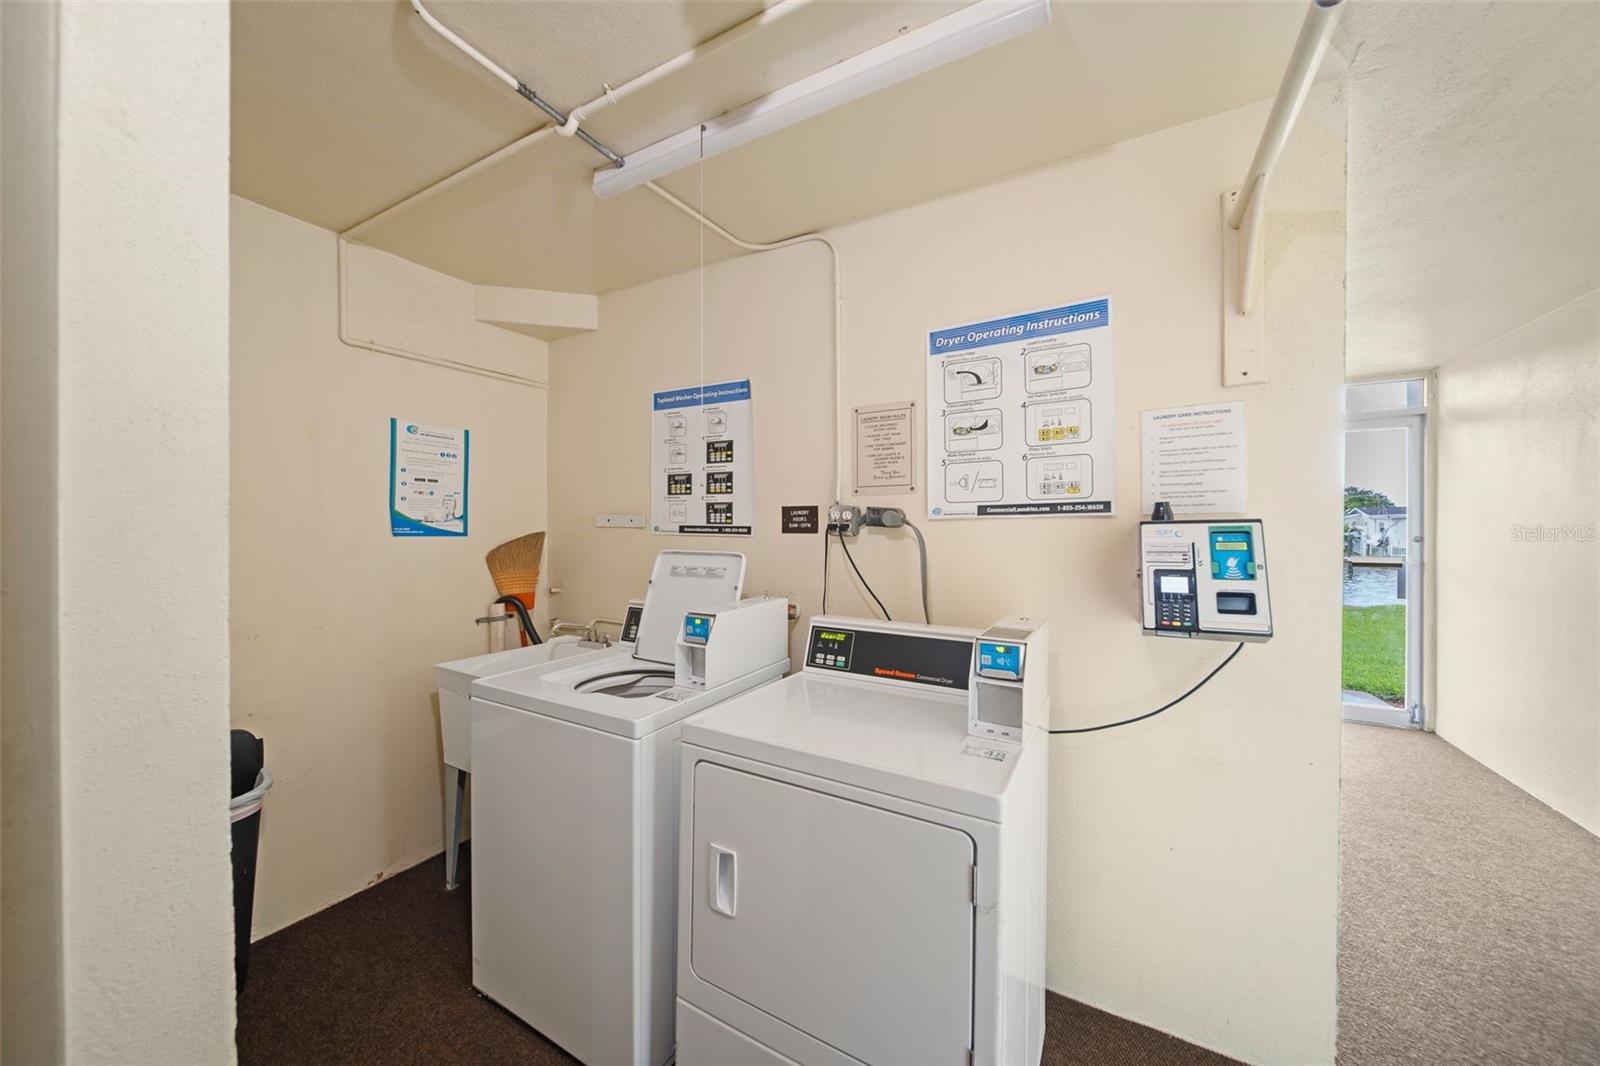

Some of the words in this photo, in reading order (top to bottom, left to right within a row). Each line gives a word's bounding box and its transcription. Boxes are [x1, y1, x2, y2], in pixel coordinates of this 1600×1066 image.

[936, 335, 965, 349] Dryer
[967, 325, 1024, 343] Operating
[1026, 310, 1101, 331] Instructions
[1021, 347, 1026, 356] 2
[941, 360, 945, 368] 1
[718, 387, 749, 396] Instructions
[1021, 401, 1026, 409] 4
[941, 409, 946, 417] 3
[1193, 409, 1231, 417] INSTRUCTIONS
[1022, 453, 1028, 462] 6
[941, 458, 946, 467] 5
[874, 667, 895, 676] Speed
[916, 674, 941, 683] Commercial
[941, 677, 954, 685] Dryer
